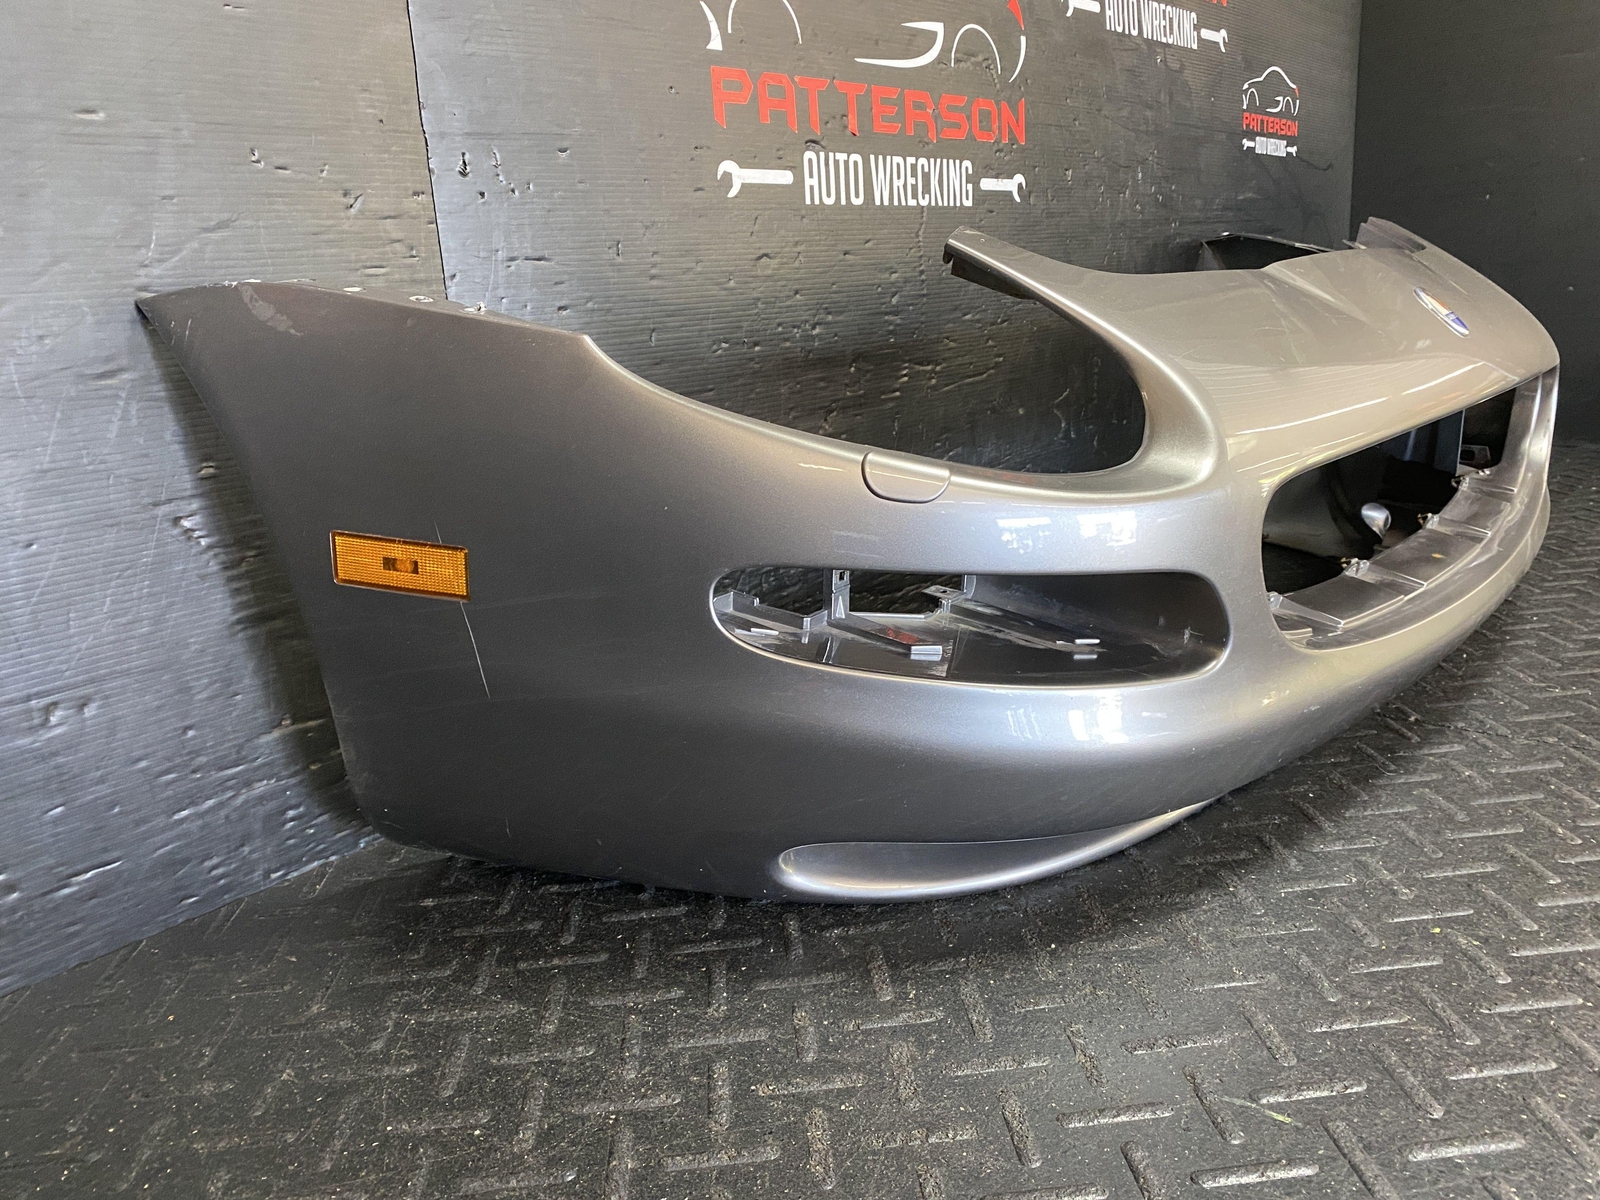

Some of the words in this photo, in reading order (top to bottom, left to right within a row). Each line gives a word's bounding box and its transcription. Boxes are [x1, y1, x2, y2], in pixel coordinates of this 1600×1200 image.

[1105, 0, 1139, 36] AUTO
[1140, 0, 1198, 50] WRECKING
[710, 65, 1026, 145] PATTERSON
[1243, 112, 1298, 137] PATTERSON
[803, 150, 865, 205] AUTO
[870, 154, 973, 207] WRECKING
